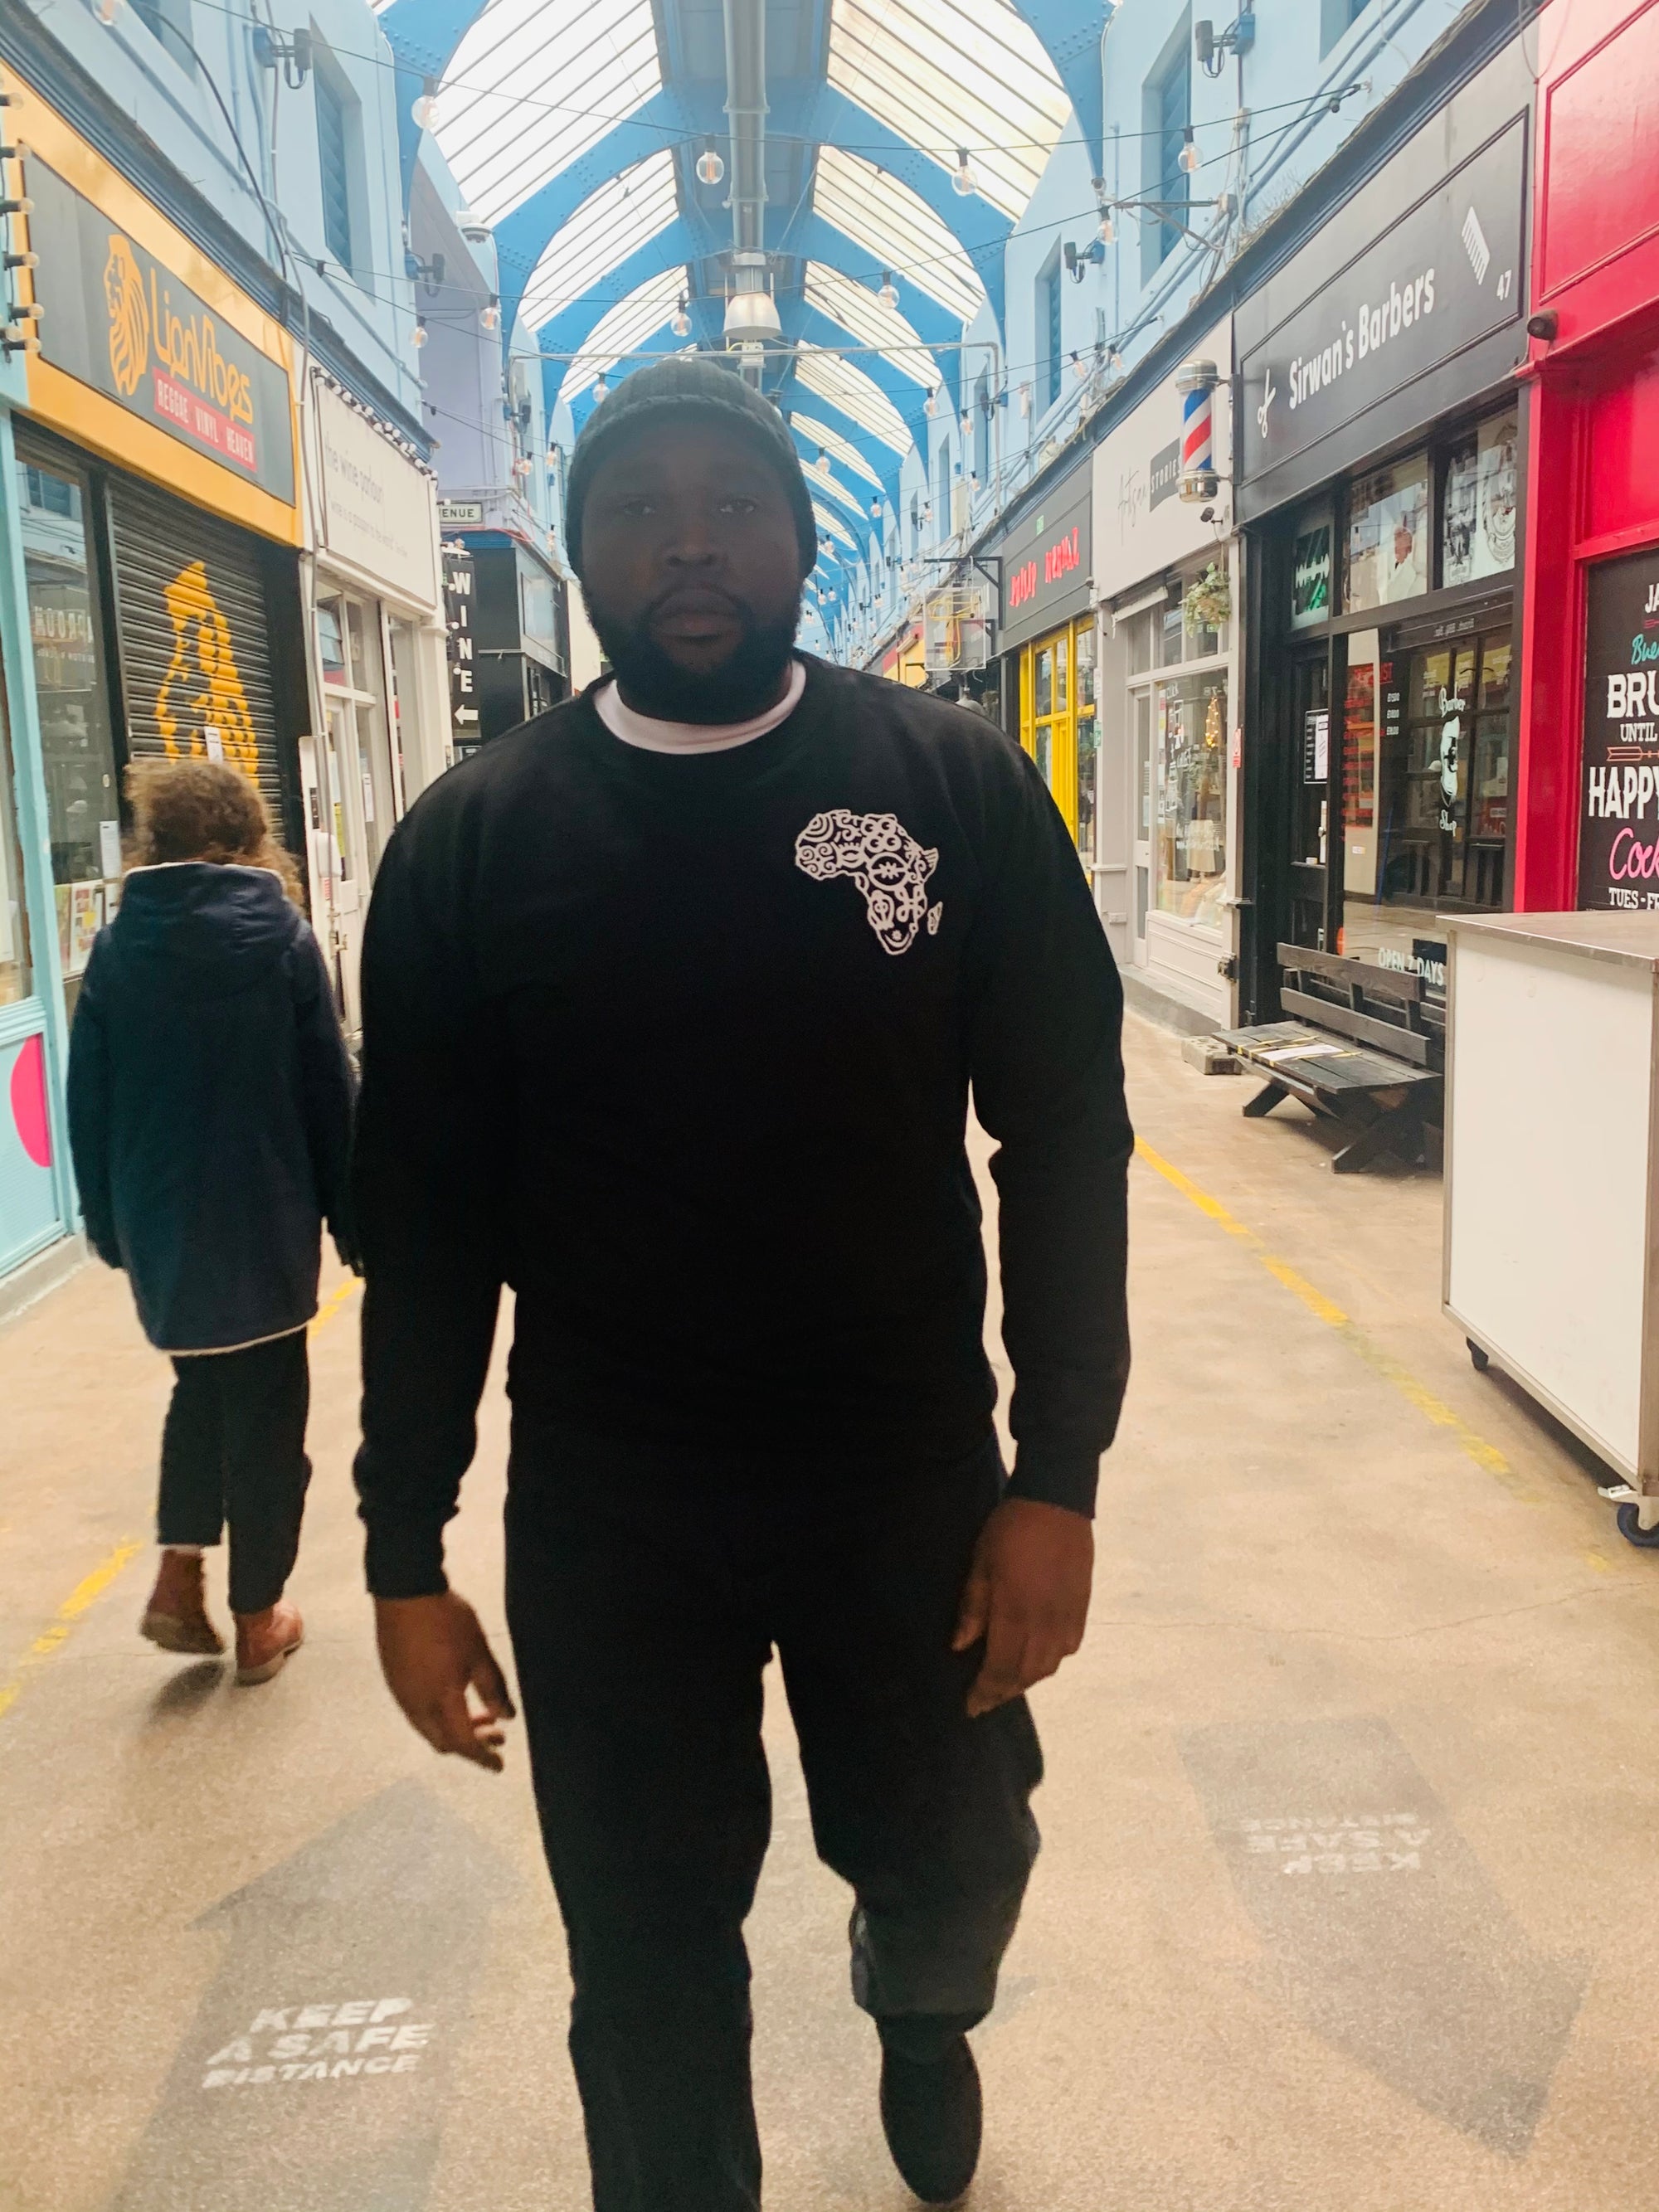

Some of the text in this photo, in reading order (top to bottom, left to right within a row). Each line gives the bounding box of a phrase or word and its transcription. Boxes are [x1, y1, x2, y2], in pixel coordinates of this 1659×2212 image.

[1496, 270, 1512, 301] 47
[1289, 268, 1435, 410] Sirwan's Barbers
[158, 379, 254, 464] REGGAE VINYL HEAVEN
[1150, 457, 1180, 494] STORIE
[440, 508, 475, 518] ENUE
[453, 571, 473, 693] WINE
[1438, 683, 1466, 717] Barber
[1620, 722, 1658, 743] UNTIL
[1439, 809, 1457, 837] Shop
[1609, 827, 1659, 881] Coc
[1379, 947, 1405, 973] OPEN
[1417, 956, 1445, 987] DAYS
[250, 1997, 412, 2032] KEEP
[205, 2023, 435, 2064] A SAFE
[202, 2054, 421, 2089] DISTANCE
